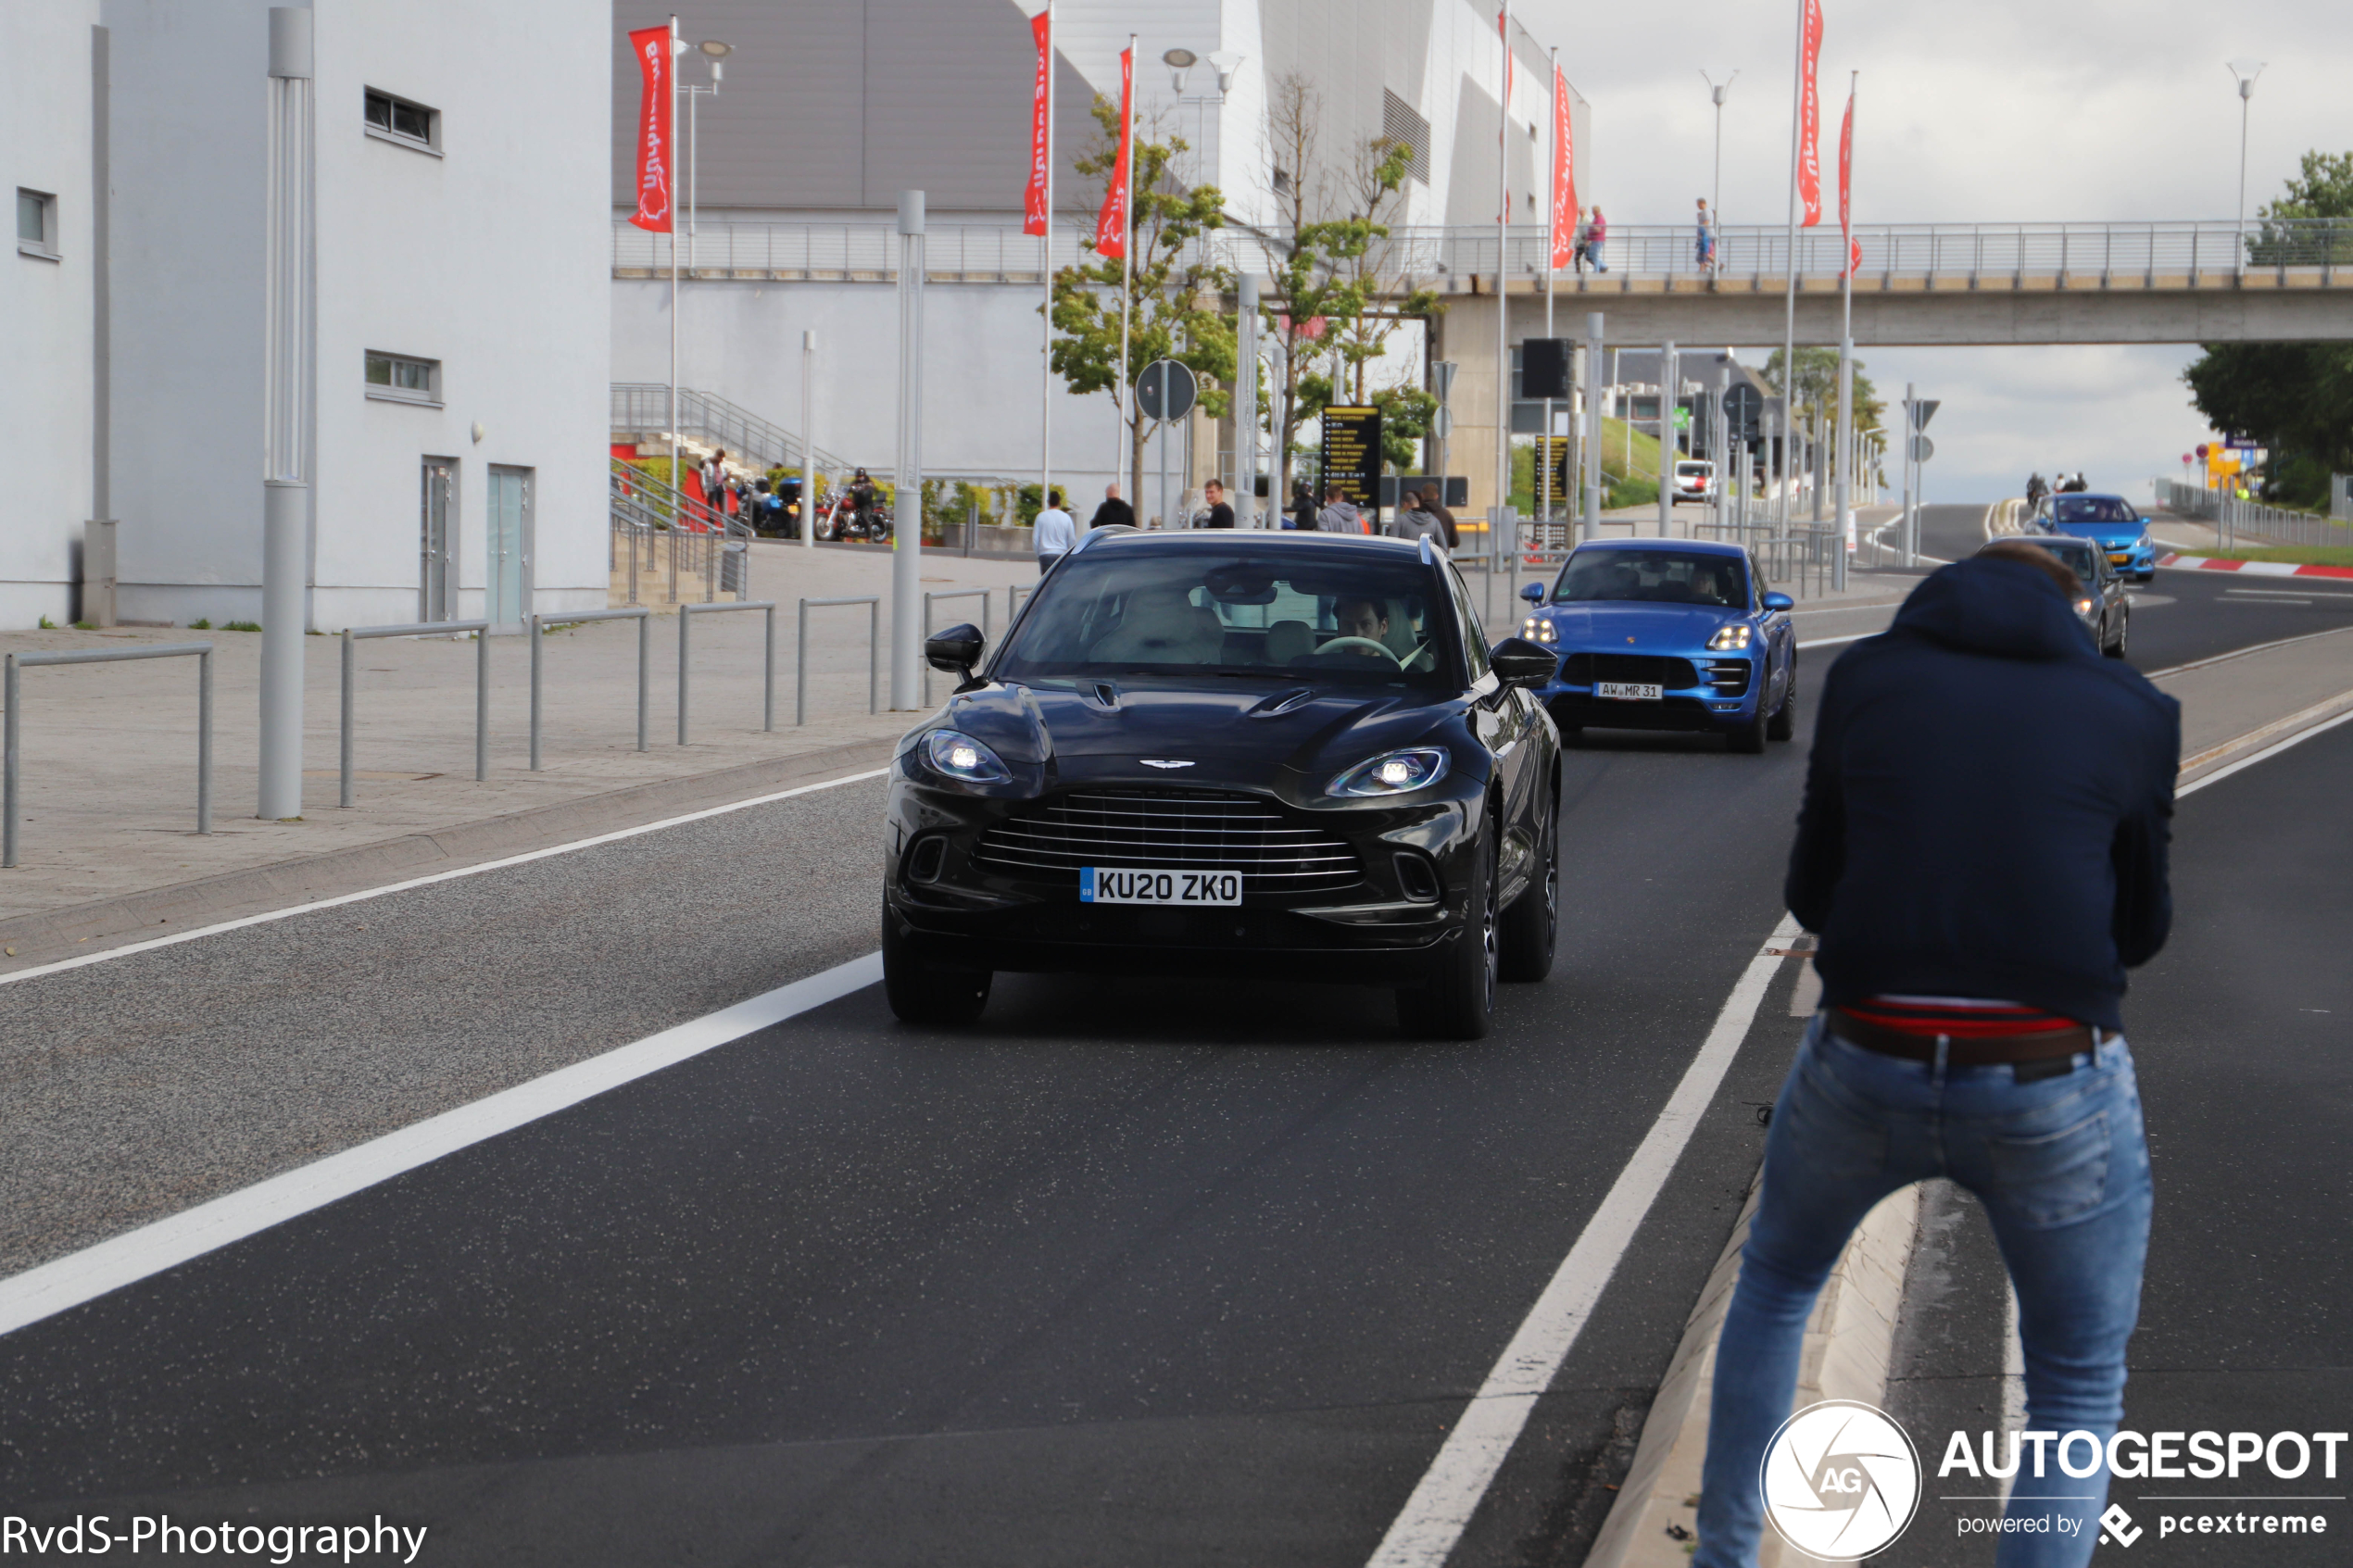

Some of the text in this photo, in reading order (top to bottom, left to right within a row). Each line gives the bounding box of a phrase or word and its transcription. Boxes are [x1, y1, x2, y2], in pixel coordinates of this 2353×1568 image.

[1603, 684, 1657, 697] AW MR 31
[1099, 872, 1237, 901] KU20 ZKO
